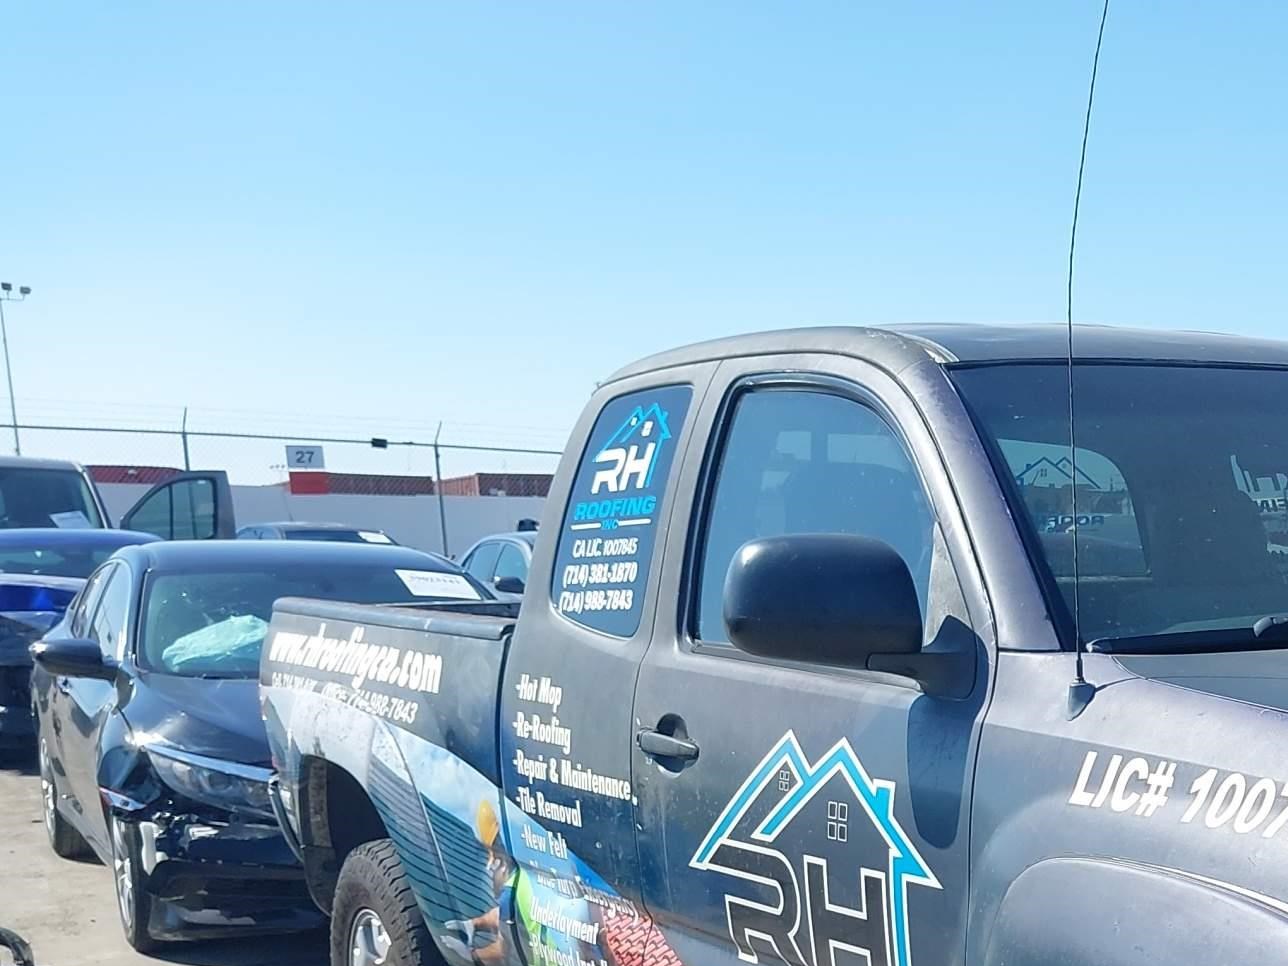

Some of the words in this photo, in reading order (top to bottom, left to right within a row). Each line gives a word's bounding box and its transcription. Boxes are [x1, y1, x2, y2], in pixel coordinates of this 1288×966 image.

[295, 450, 314, 464] 27
[591, 441, 656, 494] RH
[574, 495, 657, 521] ROOFING
[601, 518, 619, 530] INC
[572, 539, 587, 558] CA
[603, 537, 638, 556] 1007845
[562, 563, 590, 589] (714)
[590, 561, 638, 584] 381-1870
[559, 591, 584, 615] (714)
[584, 589, 633, 612] 988-7843
[515, 674, 538, 700] -Hot
[538, 677, 562, 713] Mop
[512, 711, 571, 755] -Re-Roofing
[512, 749, 547, 785] -Repair
[549, 758, 559, 784] &
[1069, 750, 1177, 817] LIC#
[515, 787, 536, 815] -Tile
[537, 791, 582, 828] Removal
[521, 823, 546, 853] -New
[548, 830, 568, 860] Felt
[530, 895, 599, 945] Underlayment
